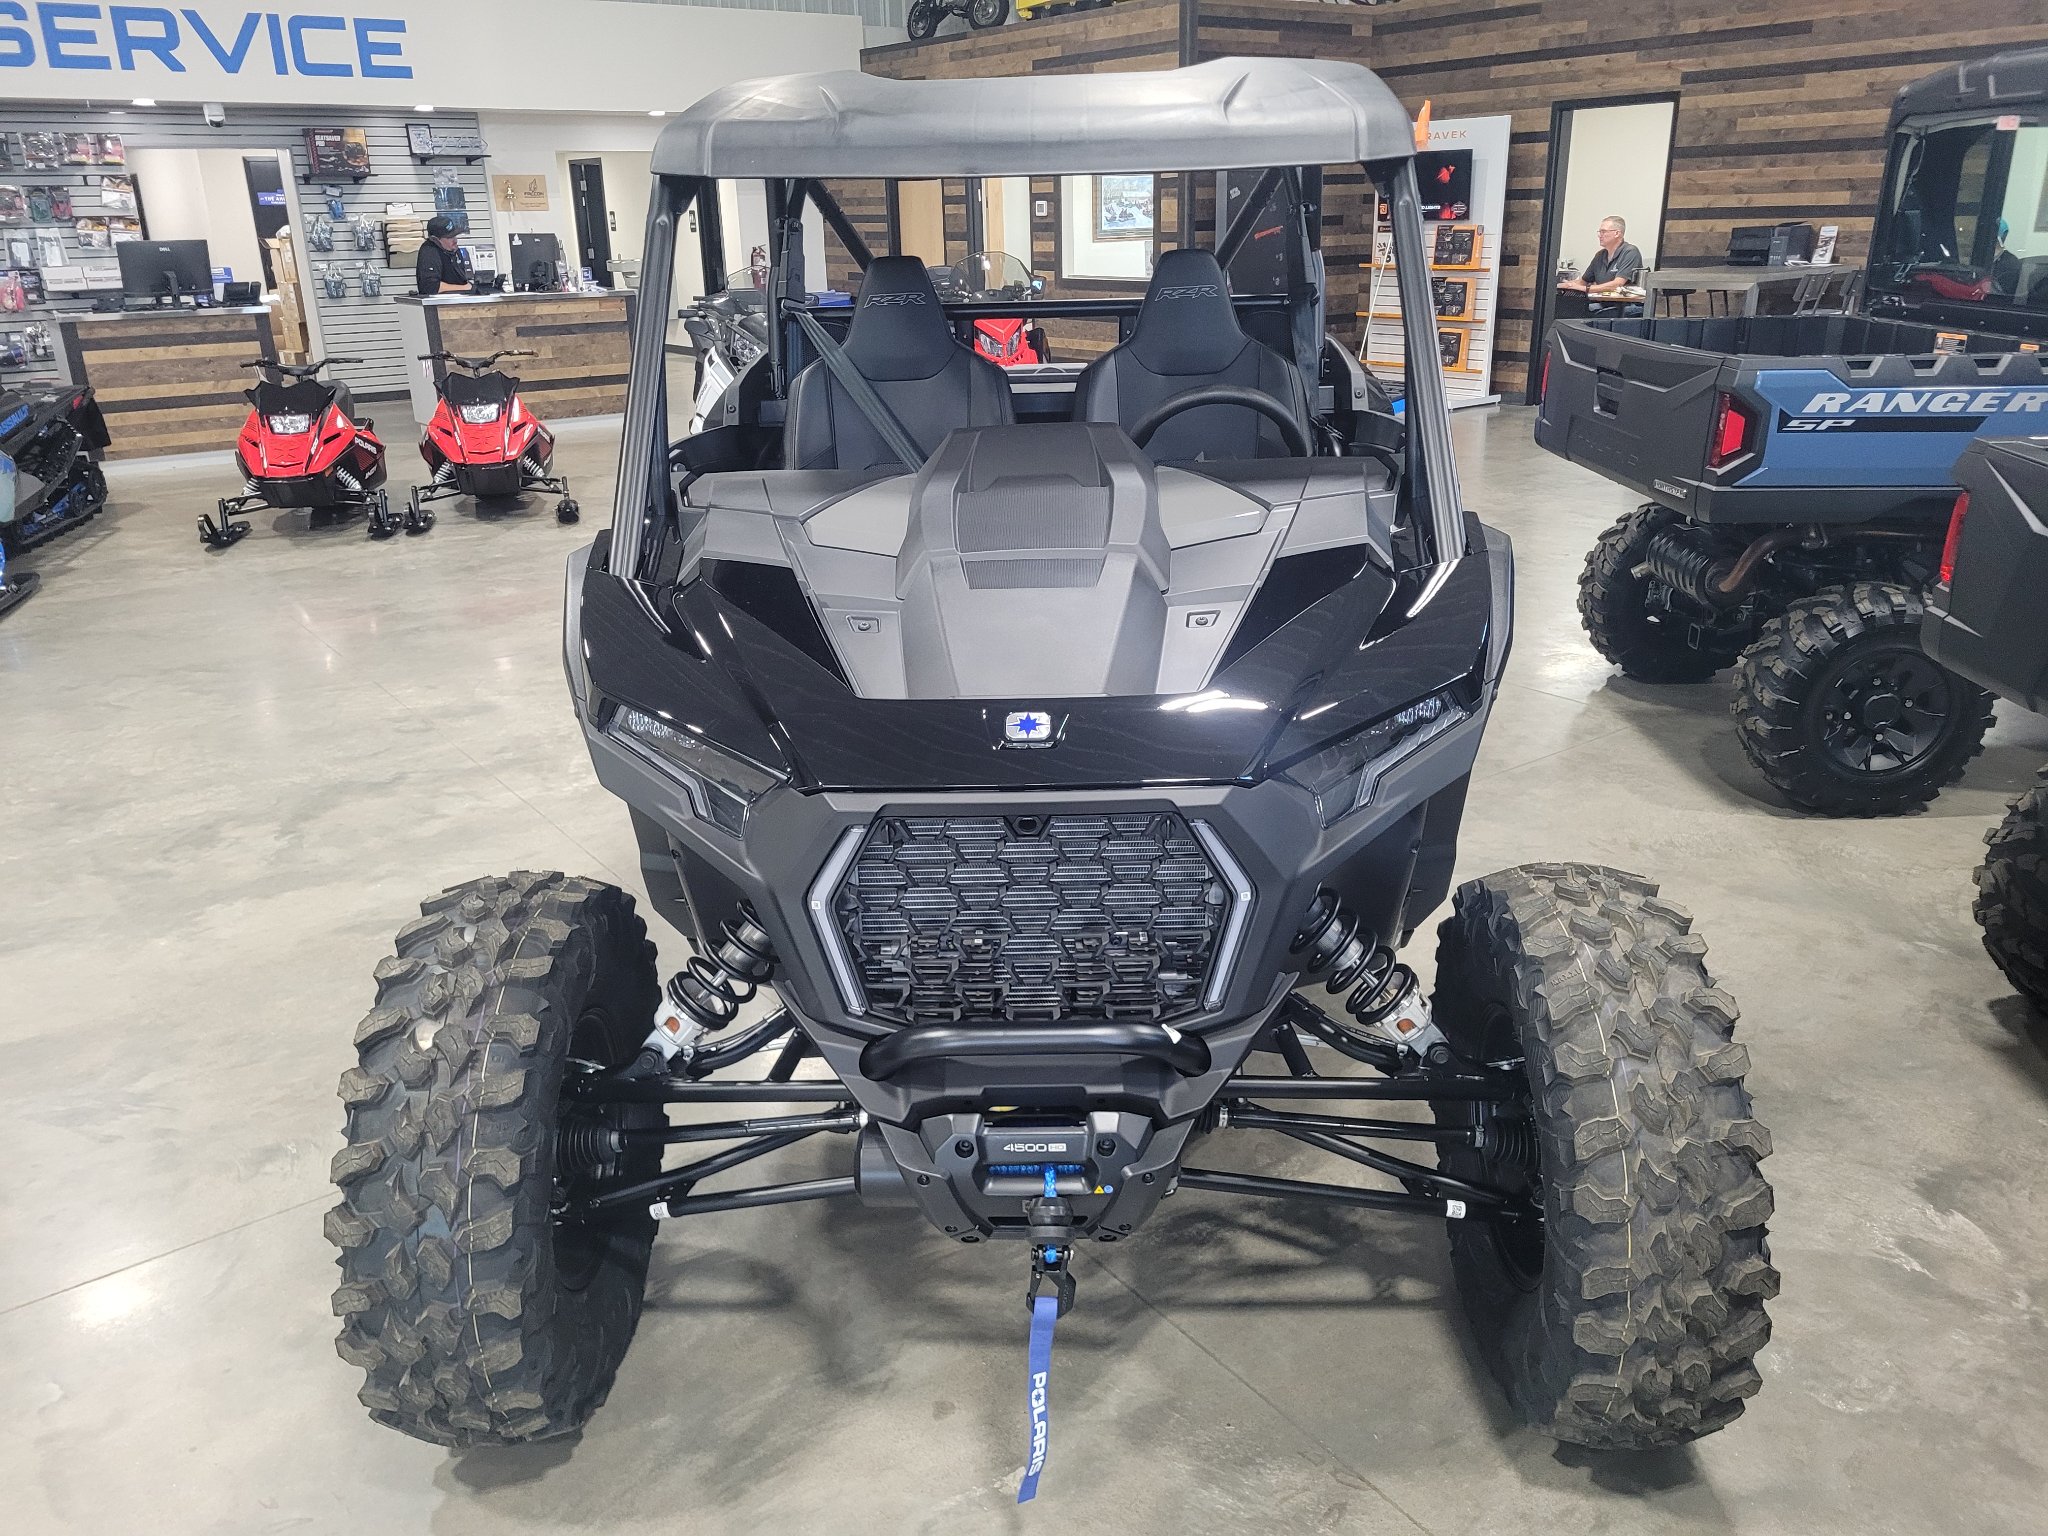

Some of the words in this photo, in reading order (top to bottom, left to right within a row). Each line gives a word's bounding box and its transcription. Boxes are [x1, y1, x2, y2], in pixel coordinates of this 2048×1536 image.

[0, 1, 414, 80] SERVICE
[863, 292, 926, 309] RZR
[1154, 284, 1219, 302] RZR
[1801, 392, 2048, 413] RANGER
[1781, 419, 1857, 431] SP
[1003, 1143, 1047, 1152] 4500
[1027, 1371, 1047, 1478] POLARIS
